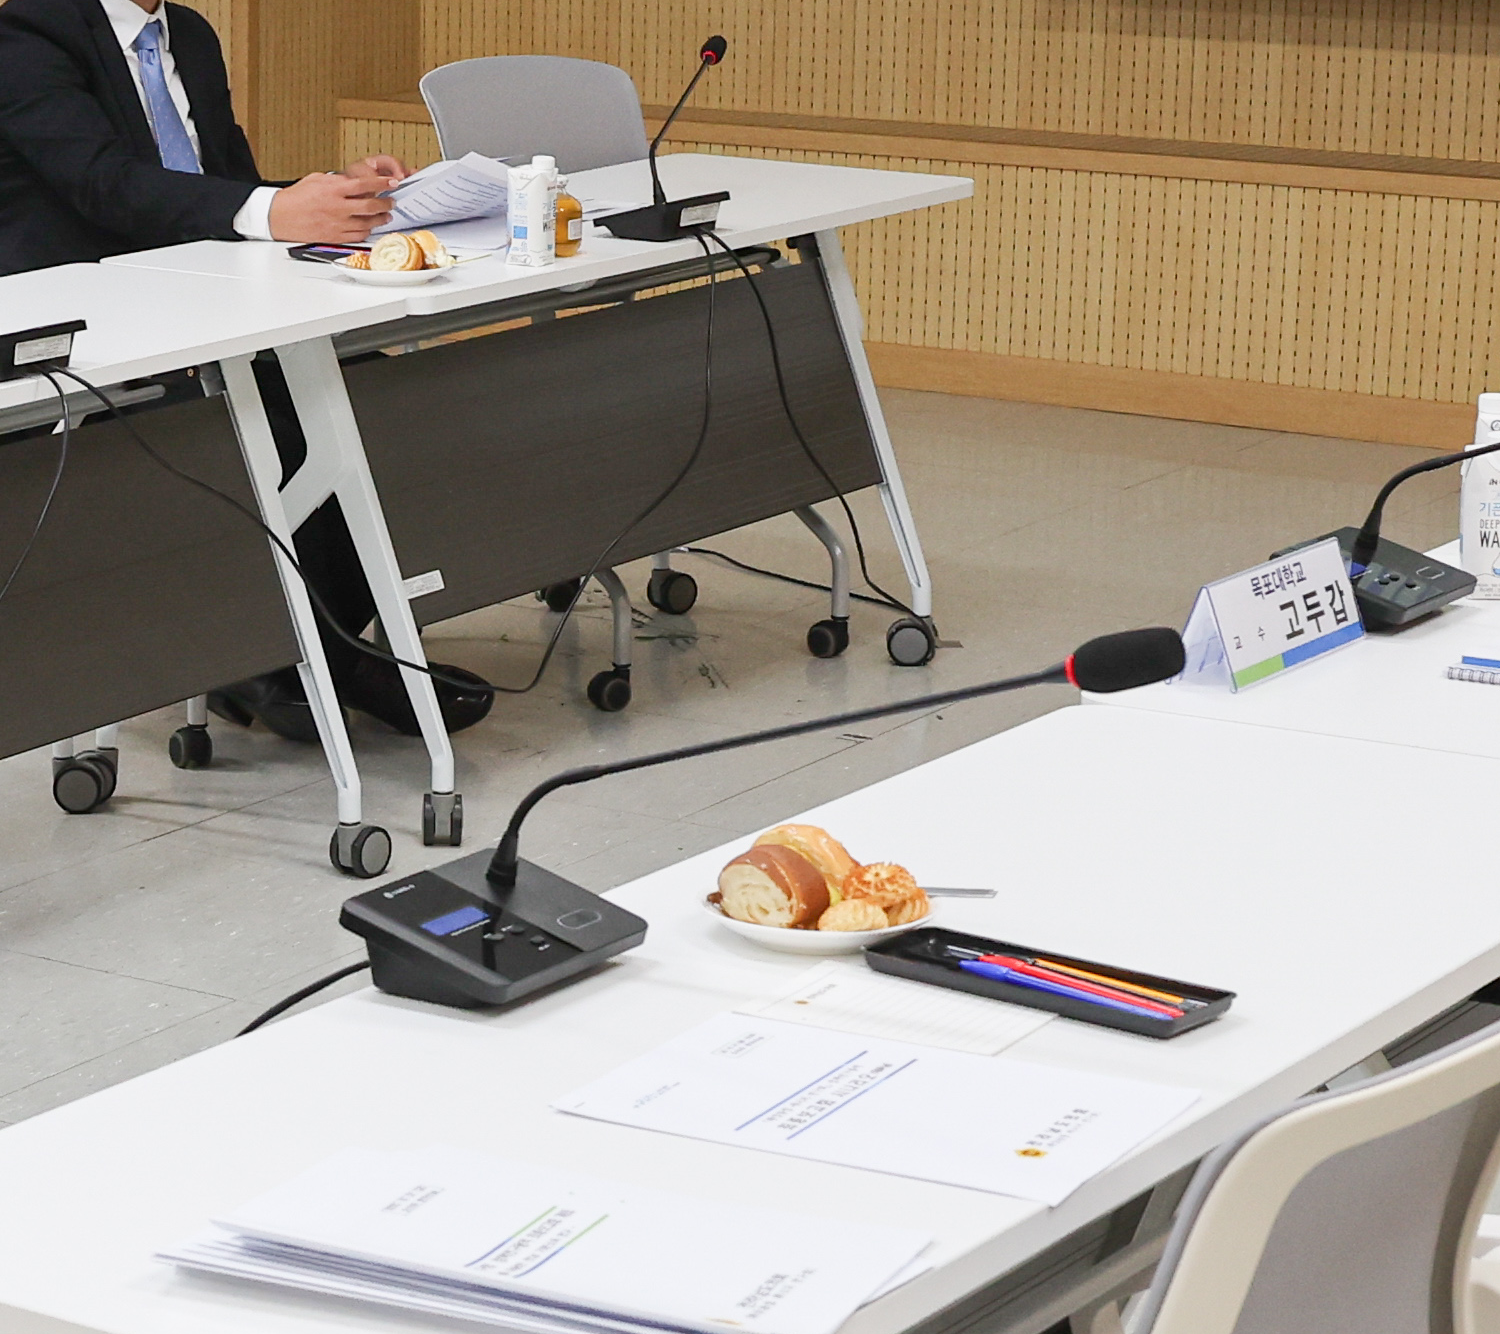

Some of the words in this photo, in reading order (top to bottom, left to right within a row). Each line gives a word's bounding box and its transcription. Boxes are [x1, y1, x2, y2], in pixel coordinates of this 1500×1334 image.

[1480, 519, 1500, 530] DEEP
[1250, 561, 1307, 600] 목포대학교
[1278, 579, 1348, 640] 고두갑
